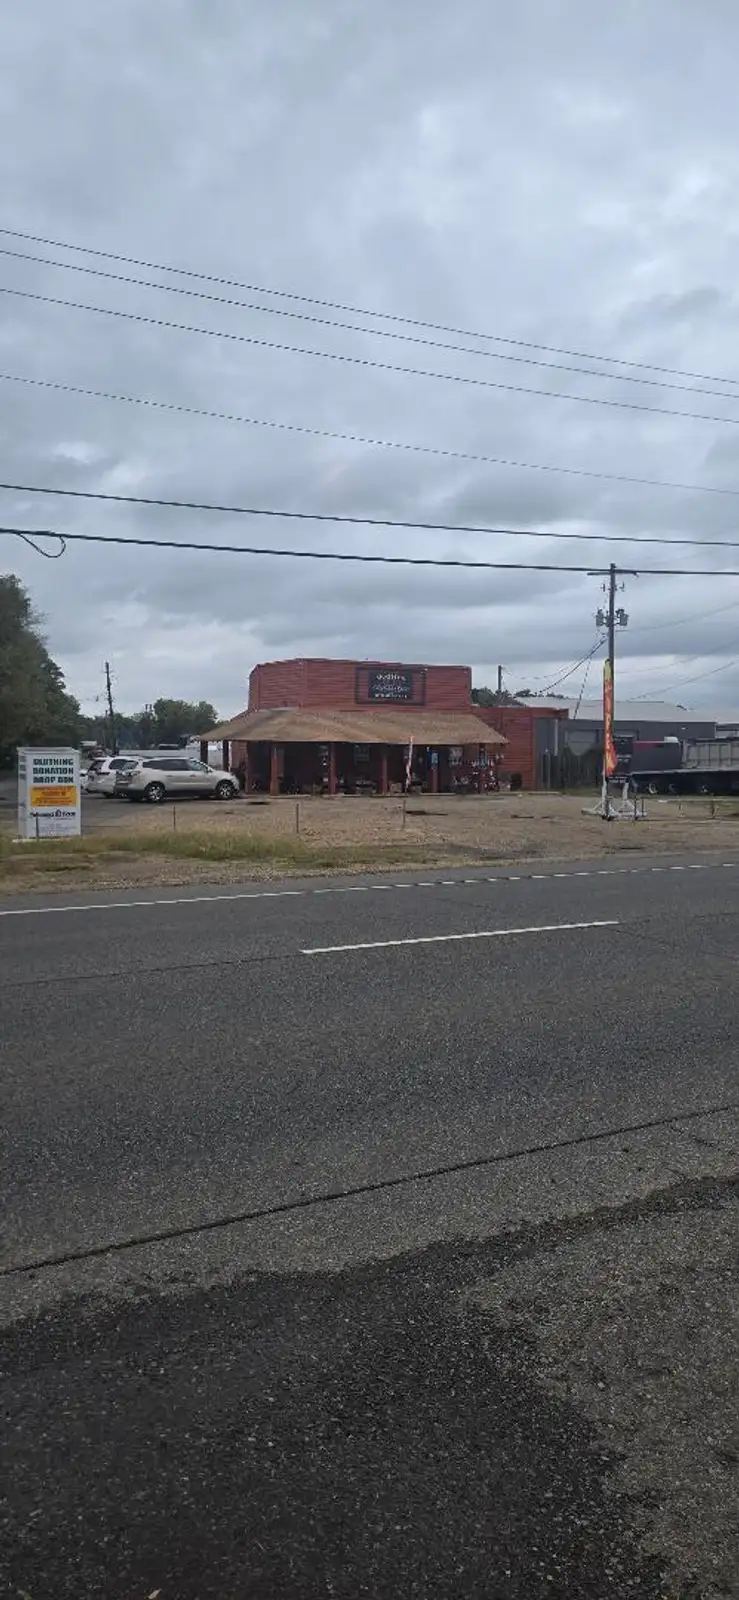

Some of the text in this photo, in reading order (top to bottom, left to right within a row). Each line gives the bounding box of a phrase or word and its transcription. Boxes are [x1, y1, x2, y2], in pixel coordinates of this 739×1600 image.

[33, 758, 74, 766] CLOTHING
[33, 767, 74, 775] DONATION
[33, 776, 56, 784] DROP
